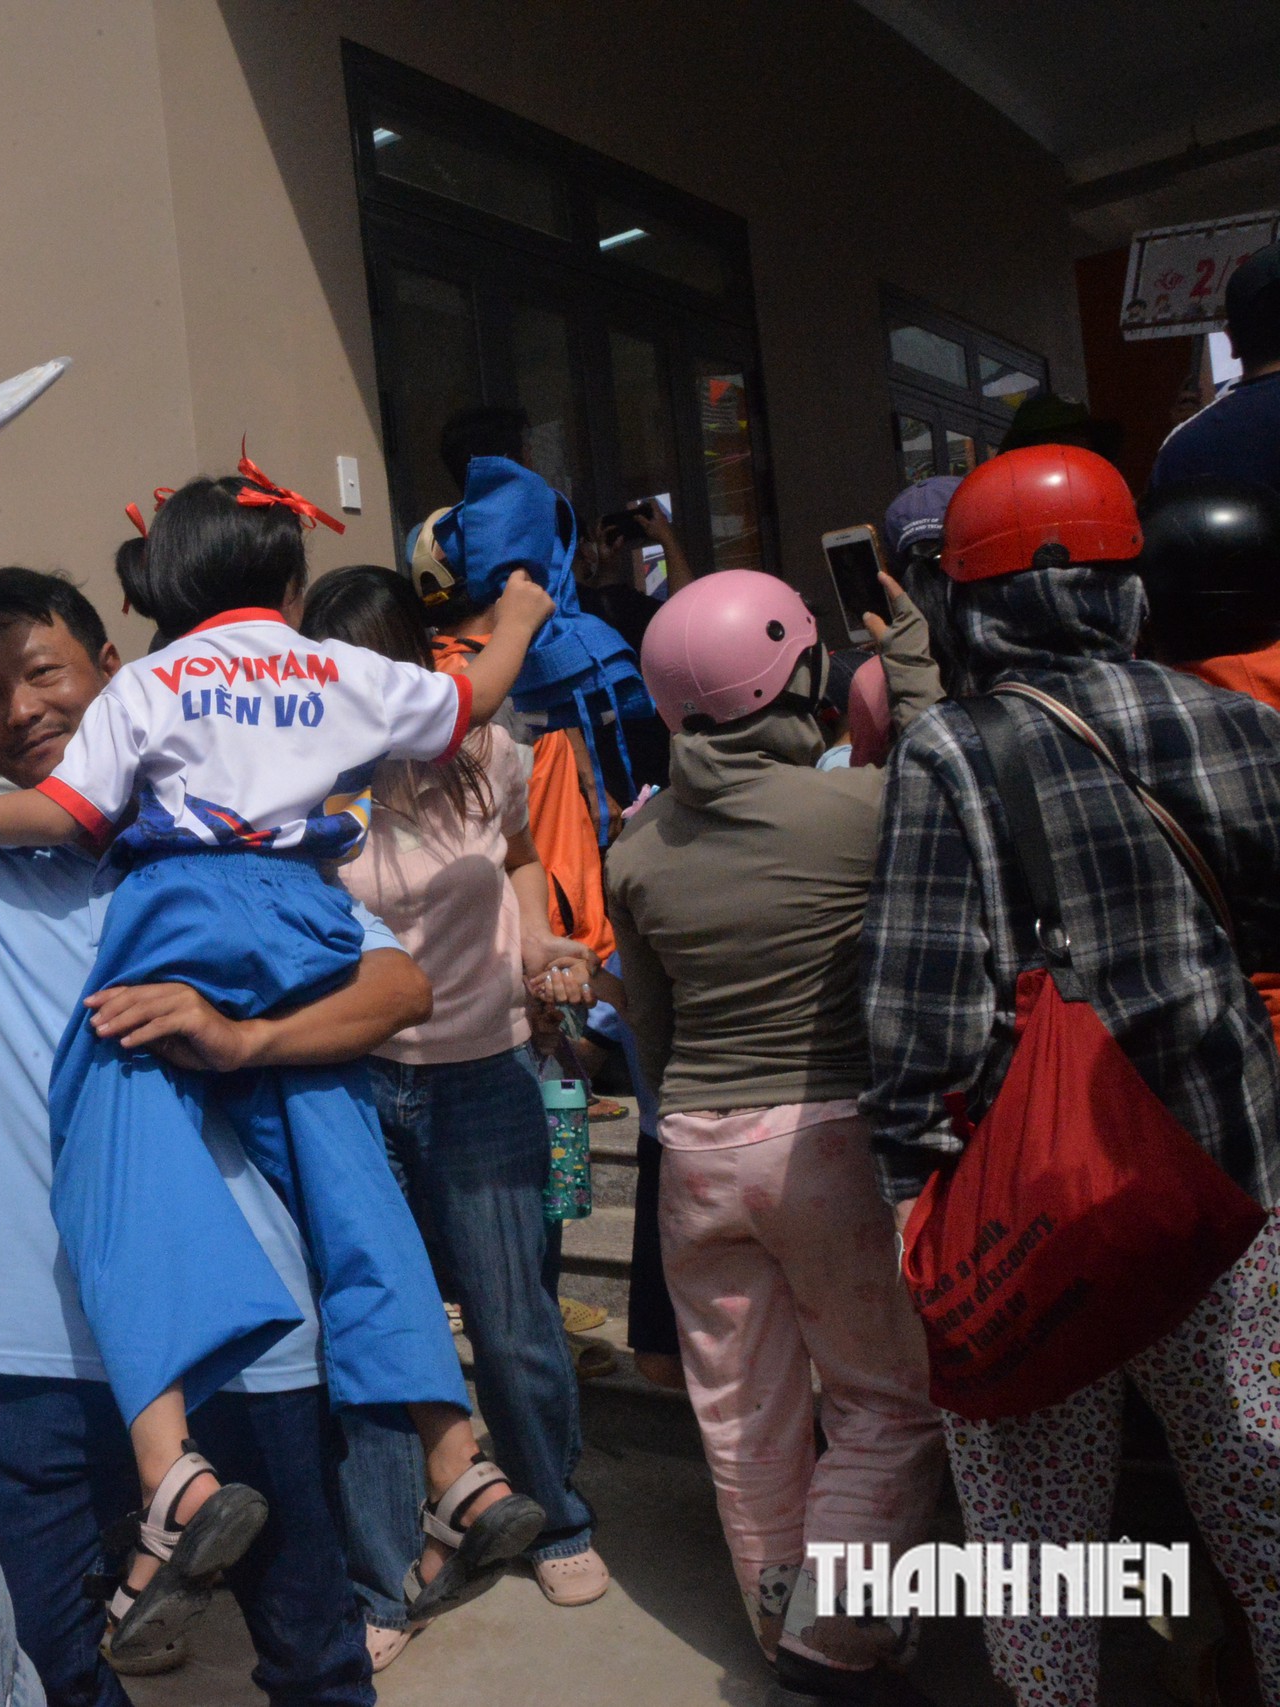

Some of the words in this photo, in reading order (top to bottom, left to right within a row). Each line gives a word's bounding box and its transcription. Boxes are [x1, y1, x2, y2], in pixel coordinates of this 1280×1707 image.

[1189, 252, 1252, 299] 2/
[151, 649, 339, 695] VOVINAM
[274, 691, 325, 727] VÕ
